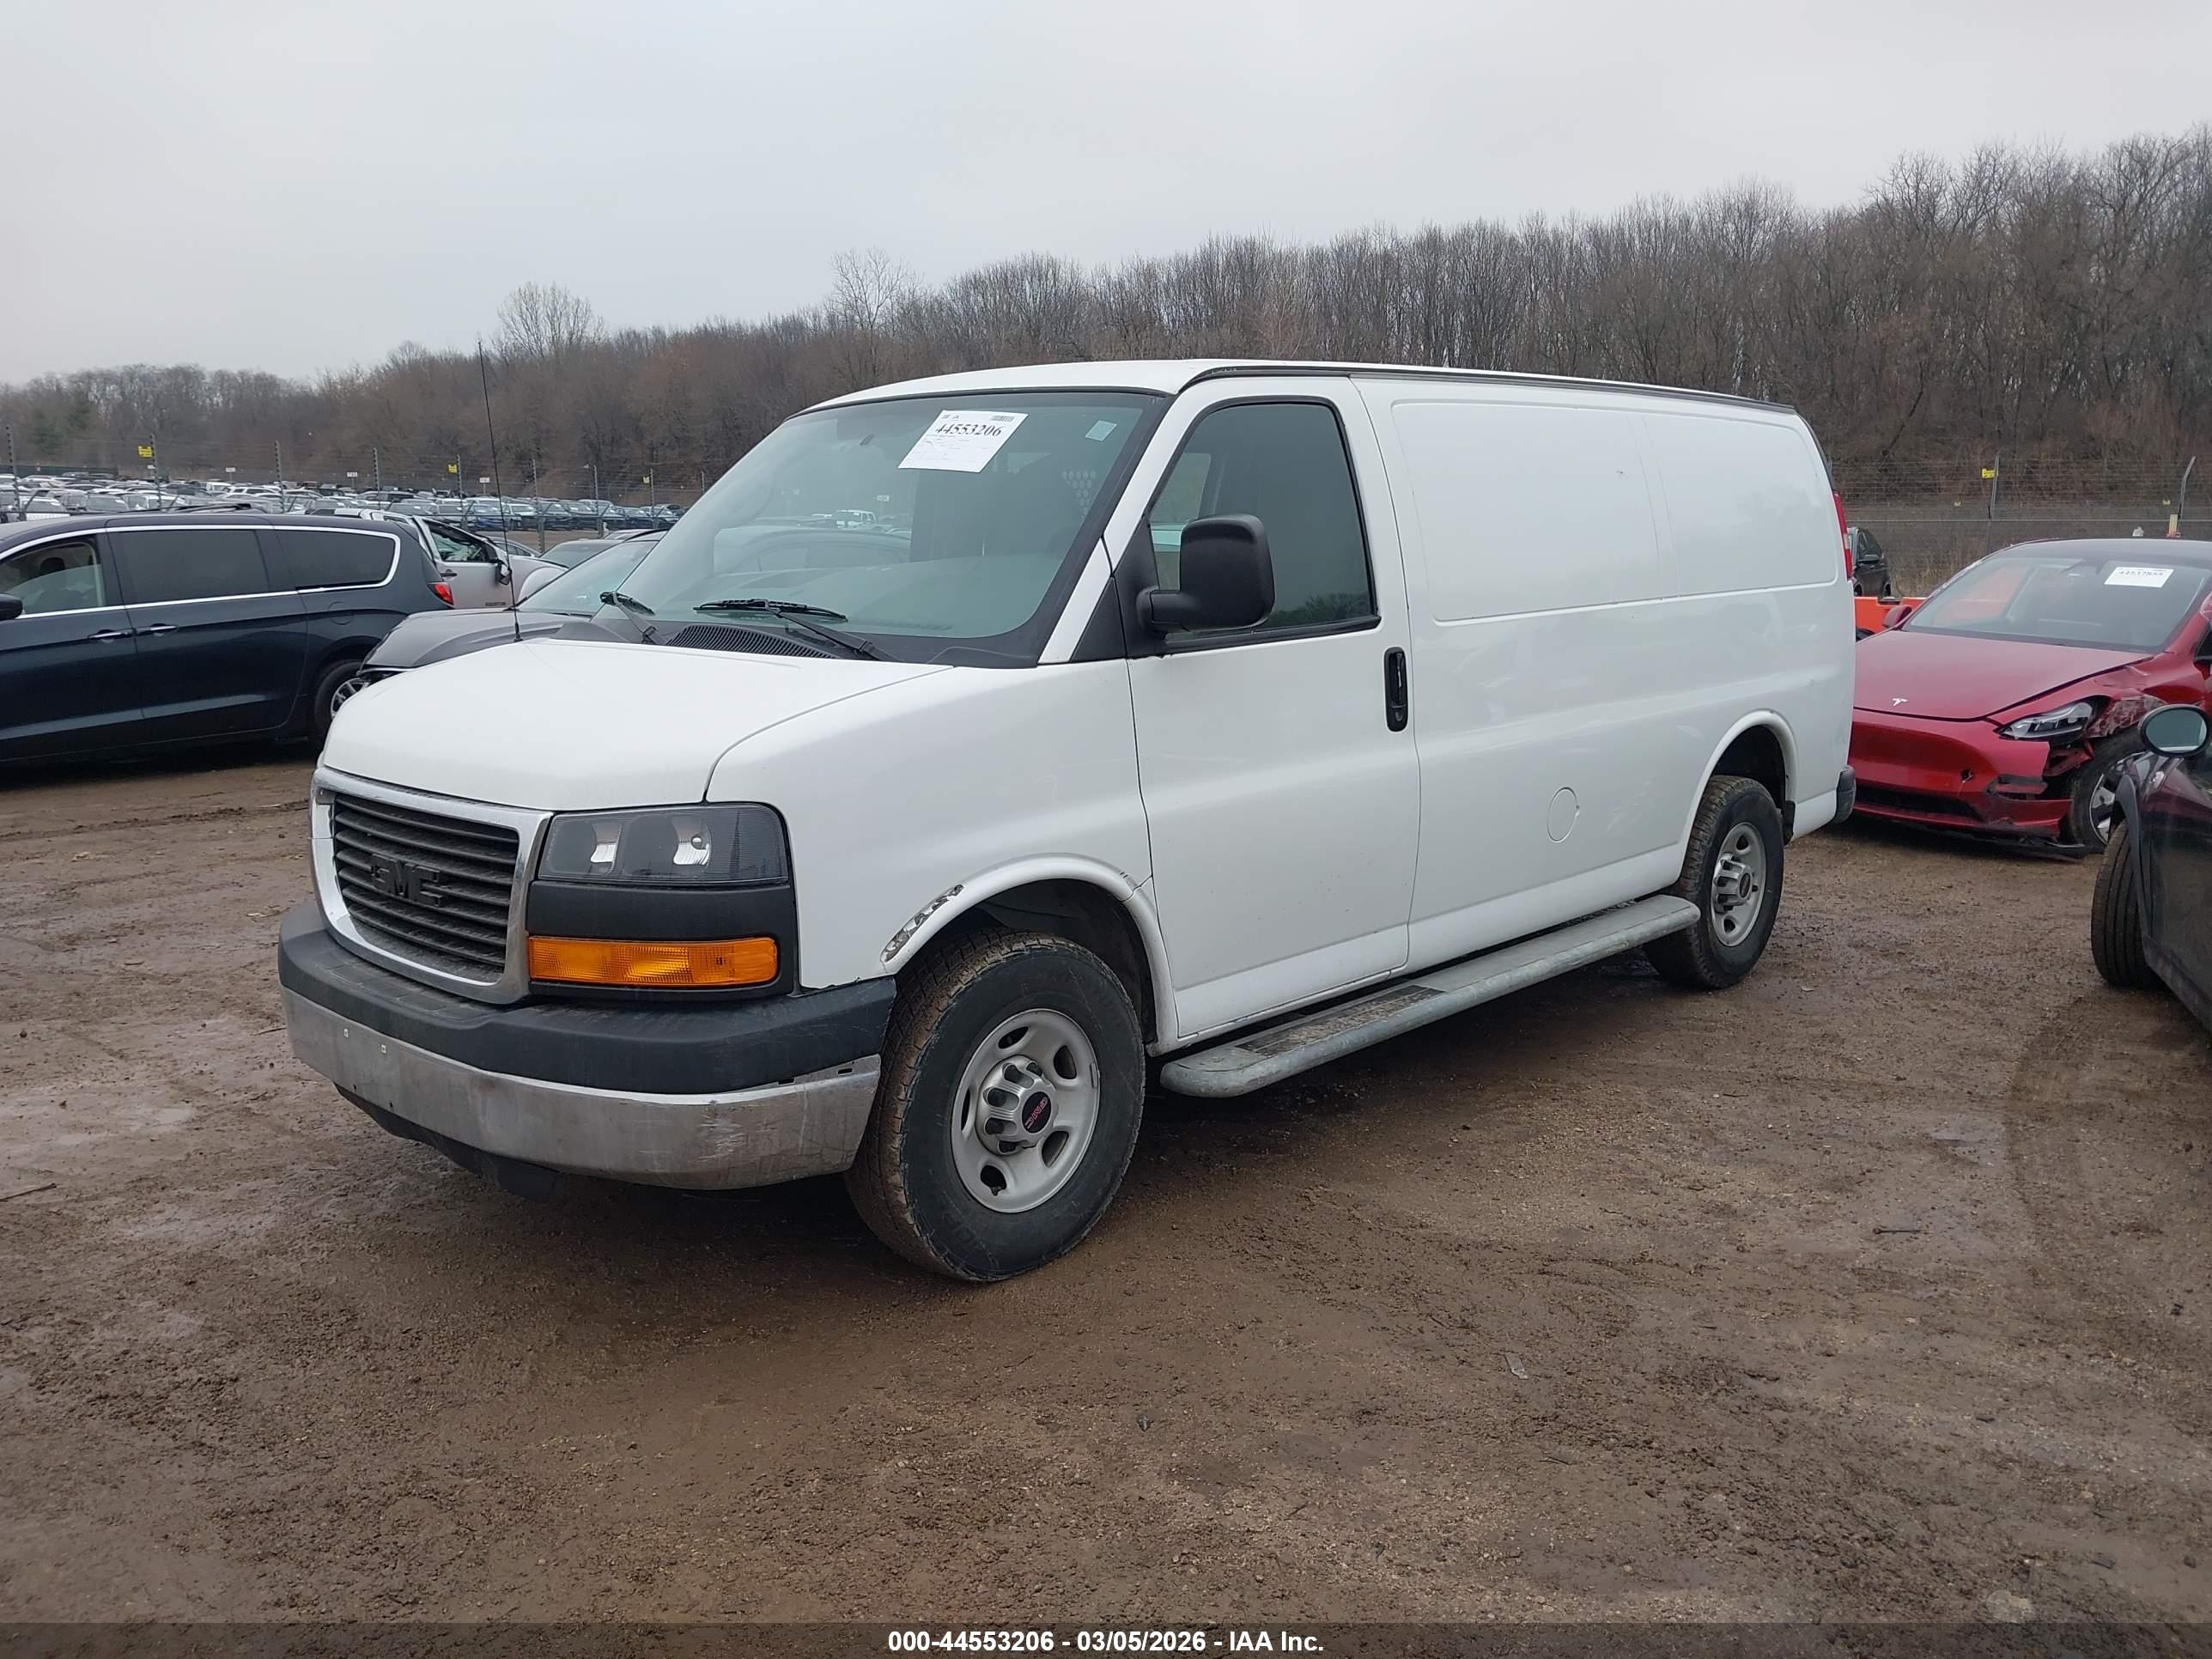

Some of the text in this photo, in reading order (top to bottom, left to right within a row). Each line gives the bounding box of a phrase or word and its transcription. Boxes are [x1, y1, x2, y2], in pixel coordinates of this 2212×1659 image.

[935, 423, 1004, 437] 44553206
[371, 854, 442, 907] GMC
[1024, 1097, 1048, 1129] GMC
